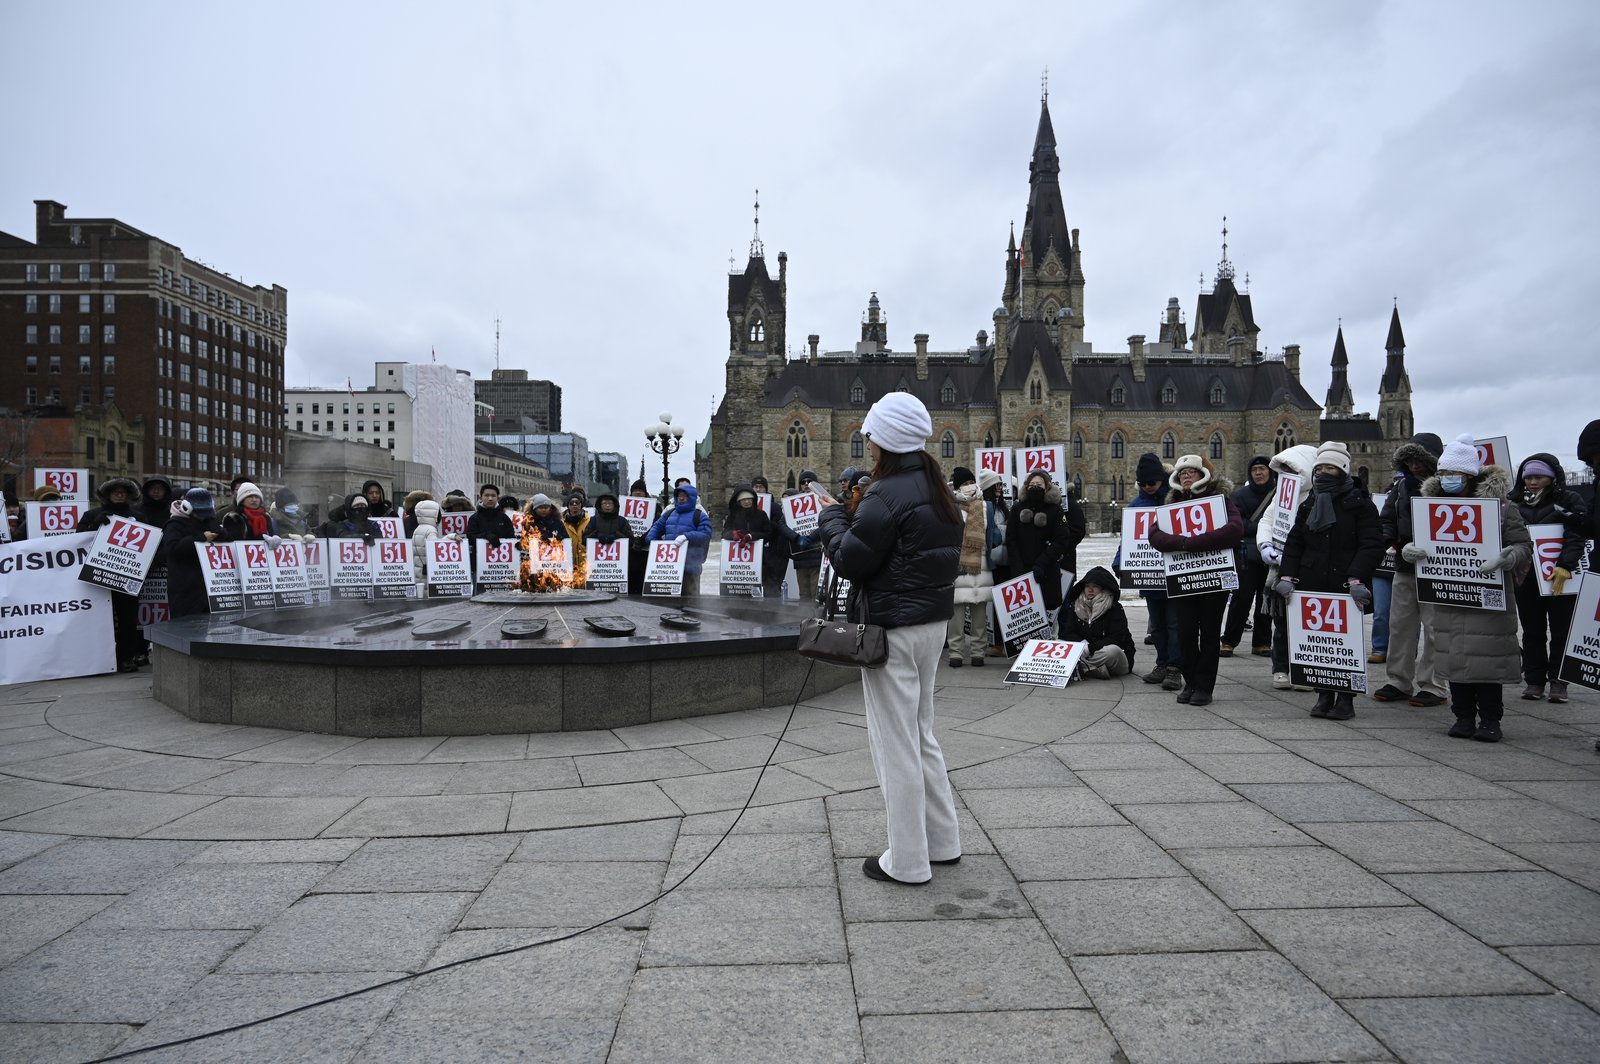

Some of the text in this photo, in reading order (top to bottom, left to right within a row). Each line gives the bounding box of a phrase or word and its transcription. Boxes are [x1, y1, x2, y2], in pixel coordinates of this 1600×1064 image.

[984, 452, 1002, 474] 37
[1028, 450, 1052, 473] 25
[49, 472, 75, 494] 39
[1280, 478, 1293, 509] 19
[628, 500, 645, 519] 16
[793, 496, 814, 518] 22
[44, 506, 75, 530] 65
[445, 516, 465, 535] 39
[1140, 512, 1158, 539] 1
[1175, 504, 1207, 538] 19
[1435, 504, 1477, 543] 23
[113, 523, 146, 551] 42
[98, 551, 141, 569] WAITING FOR
[107, 547, 136, 560] MONTHS
[209, 546, 232, 569] 34
[248, 545, 269, 568] 23
[276, 544, 297, 567] 23
[304, 543, 317, 565] 7
[343, 542, 366, 563] 55
[384, 542, 404, 563] 51
[438, 542, 460, 562] 36
[597, 542, 618, 561] 34
[657, 544, 677, 562] 35
[731, 542, 751, 562] 16
[1129, 551, 1159, 559] WAITING
[1172, 550, 1204, 562] WAITING
[1435, 545, 1477, 557] MONTHS
[90, 557, 106, 567] IRCC
[106, 561, 142, 576] RESPONSE
[1168, 556, 1229, 572] IRCC RESPONSE
[1426, 556, 1467, 567] WAITING
[92, 568, 102, 576] NO
[1187, 571, 1221, 582] TIMELINES
[1421, 566, 1496, 580] IRCC RESPONSE
[1181, 580, 1220, 591] NO RESULTS
[1432, 582, 1443, 590] NO
[1436, 591, 1447, 599] NO
[1006, 580, 1030, 611] 23
[1, 599, 92, 618] FAIRNESS
[1010, 606, 1034, 620] MONTHS
[1306, 598, 1343, 632] 34
[1005, 617, 1045, 639] IRCC RESPONSE
[1006, 616, 1030, 630] WAITING
[1030, 611, 1041, 622] FOR
[1036, 641, 1067, 659] 28
[1299, 643, 1354, 657] WAITING FOR
[1307, 635, 1343, 646] MONTHS
[1294, 652, 1360, 668] IRCC RESPONSE
[1573, 644, 1598, 659] IRCC
[1030, 667, 1067, 675] RESPONSE
[1303, 667, 1351, 679] NO TIMELINES
[1580, 663, 1596, 674] NO
[1306, 675, 1348, 687] NO RESULTS
[1582, 673, 1597, 684] NO
